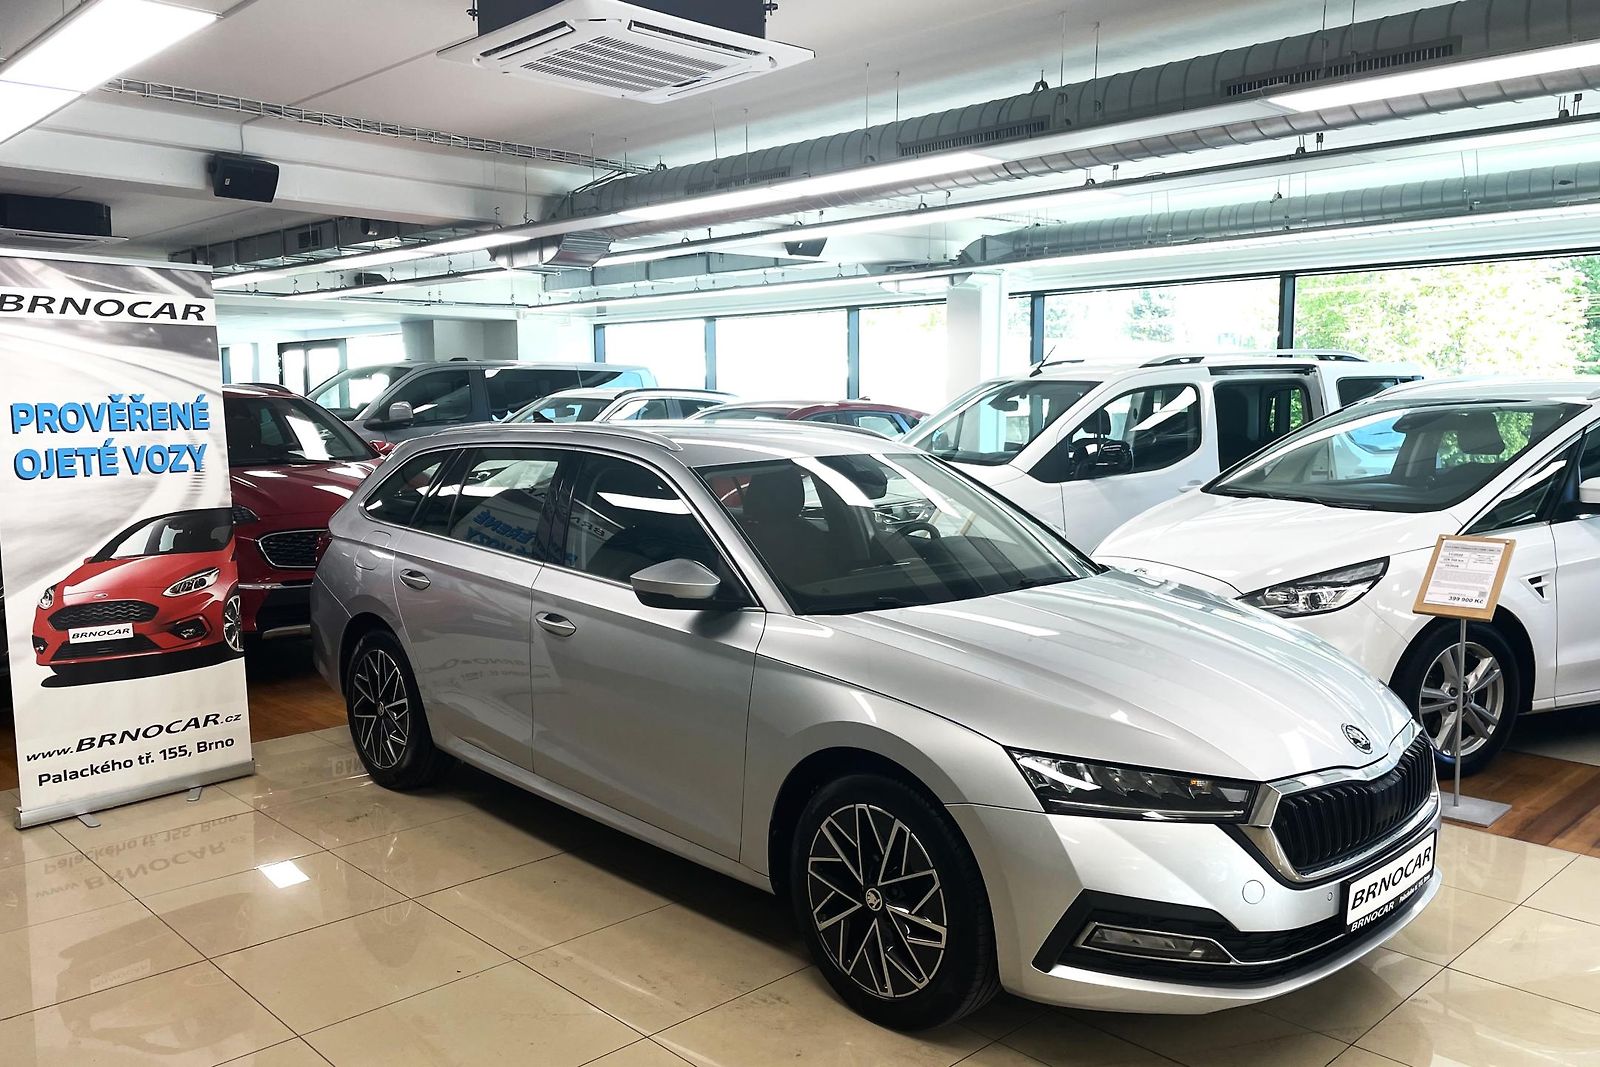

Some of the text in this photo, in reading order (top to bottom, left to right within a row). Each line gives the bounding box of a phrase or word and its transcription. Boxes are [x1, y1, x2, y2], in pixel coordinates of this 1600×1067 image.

[0, 293, 206, 321] BRNOCAR
[10, 393, 210, 434] PROVĚŘENÉ
[14, 438, 208, 480] OJETÉ VOZY
[71, 627, 130, 640] BRNOCAR
[26, 713, 242, 762] www.BRNOCAR.cz
[38, 737, 235, 787] Palackého tř. 155, Brno
[1350, 846, 1432, 911] BRNOCAR
[1350, 901, 1395, 932] BRNOCAR
